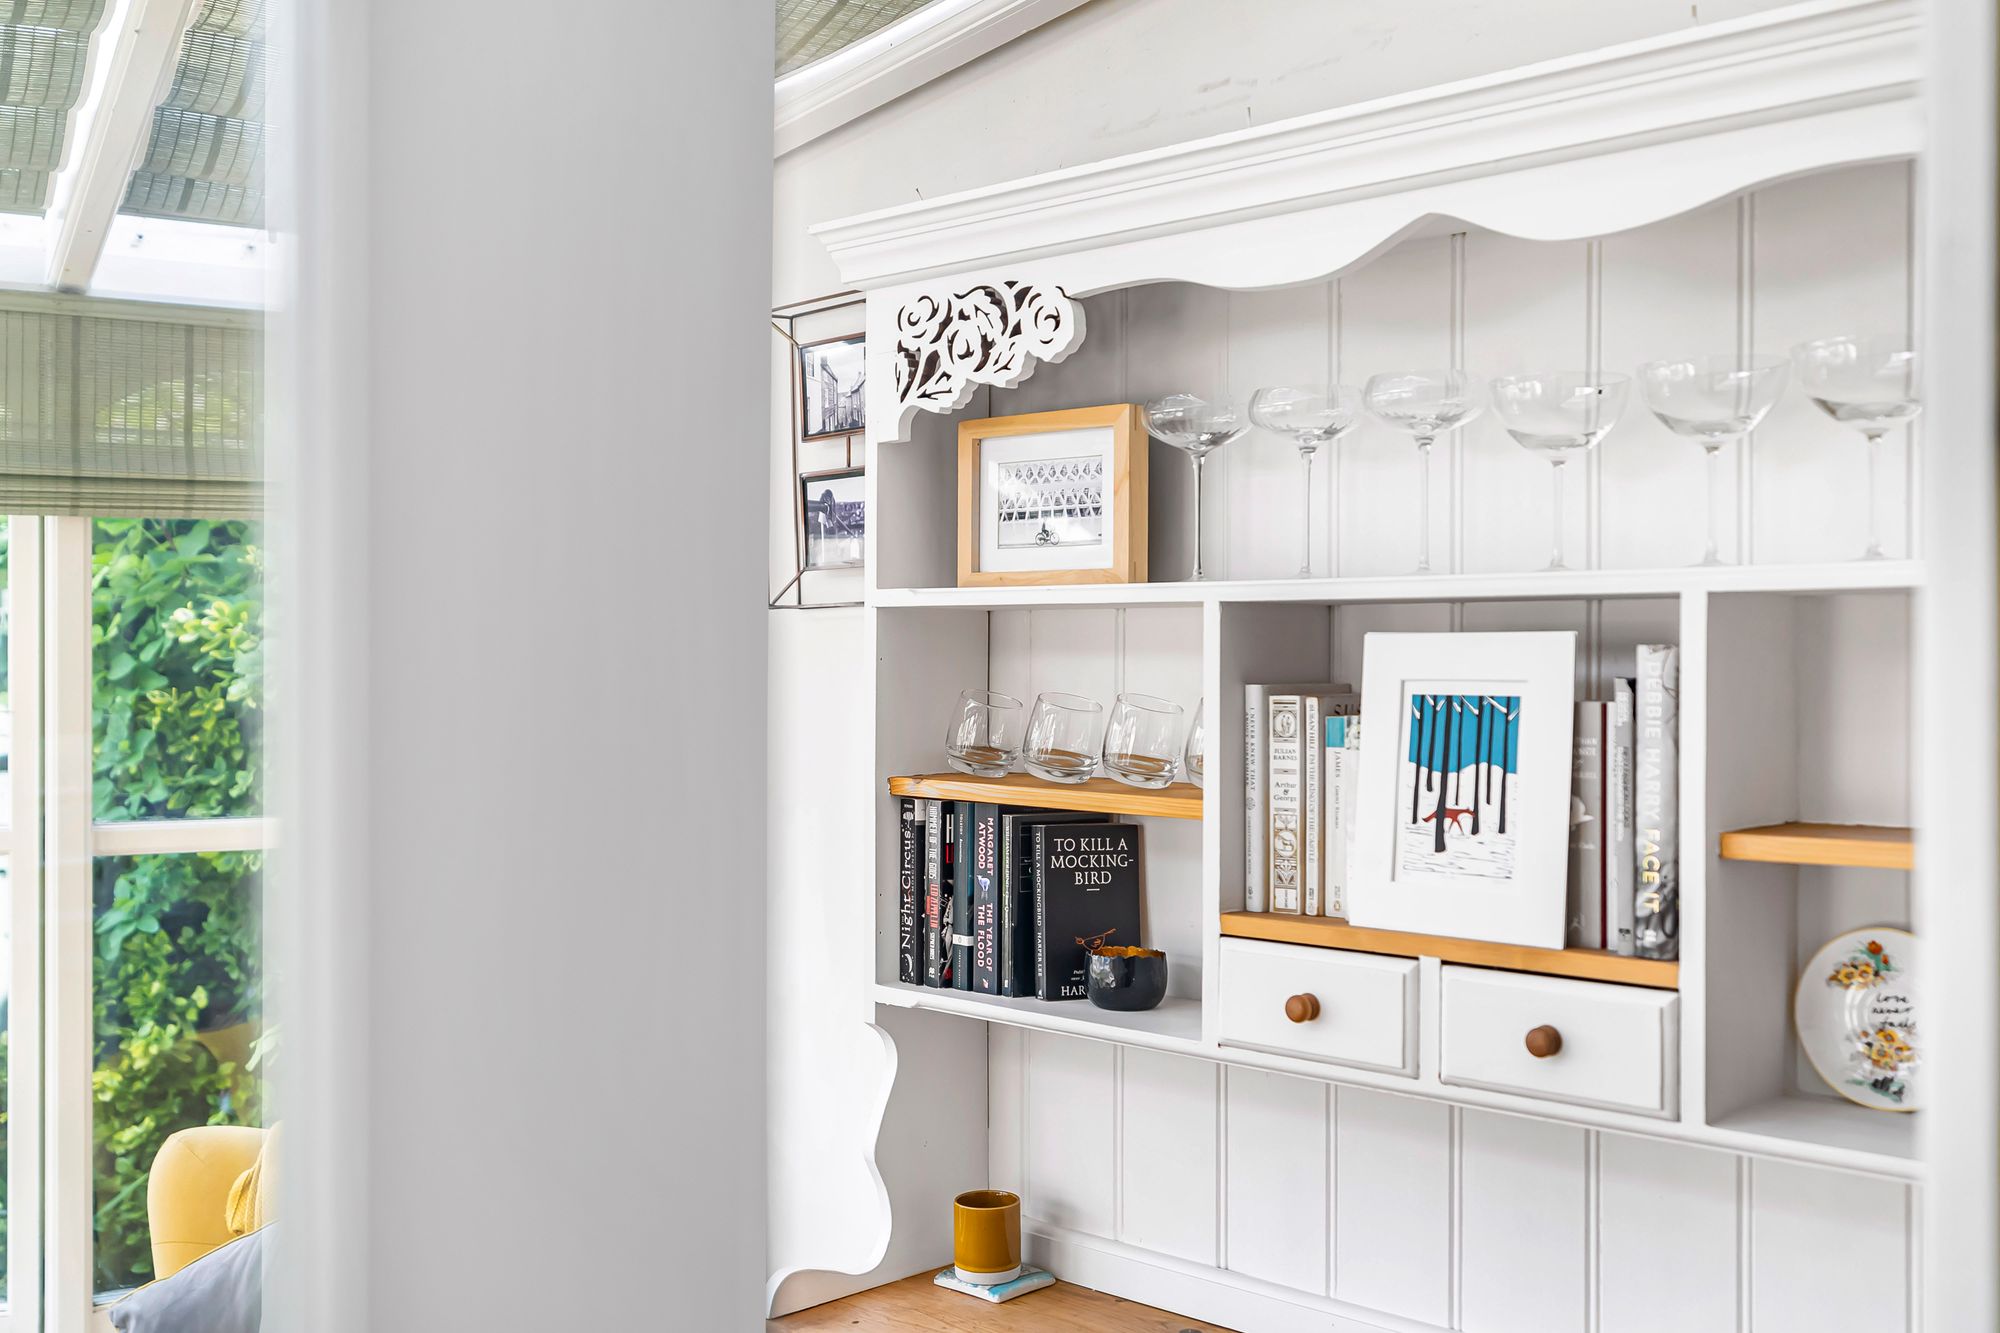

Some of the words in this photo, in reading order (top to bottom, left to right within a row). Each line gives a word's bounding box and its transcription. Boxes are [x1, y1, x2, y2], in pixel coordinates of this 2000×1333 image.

[1645, 661, 1662, 738] DEBBIE
[1645, 748, 1662, 821] HARRY
[929, 806, 938, 834] HAMMER
[929, 836, 938, 845] OF
[978, 822, 986, 870] ATWOOD
[986, 817, 994, 877] MARGARET
[1035, 831, 1041, 843] TO
[1054, 838, 1076, 852] TO
[1080, 838, 1114, 852] KILL
[1118, 838, 1128, 851] A
[902, 830, 912, 890] Circus
[929, 848, 938, 860] THE
[1051, 854, 1134, 869] MOCKING-
[1641, 828, 1661, 883] FACE
[928, 862, 937, 879] GODS
[1074, 871, 1112, 886] BIRD
[985, 903, 993, 923] THE
[1642, 891, 1660, 913] IT
[901, 894, 914, 950] Night
[977, 904, 985, 926] THE
[977, 929, 985, 968] FLOOD
[985, 926, 993, 954] YEAR
[985, 957, 993, 972] OF
[1061, 985, 1086, 996] HAR
